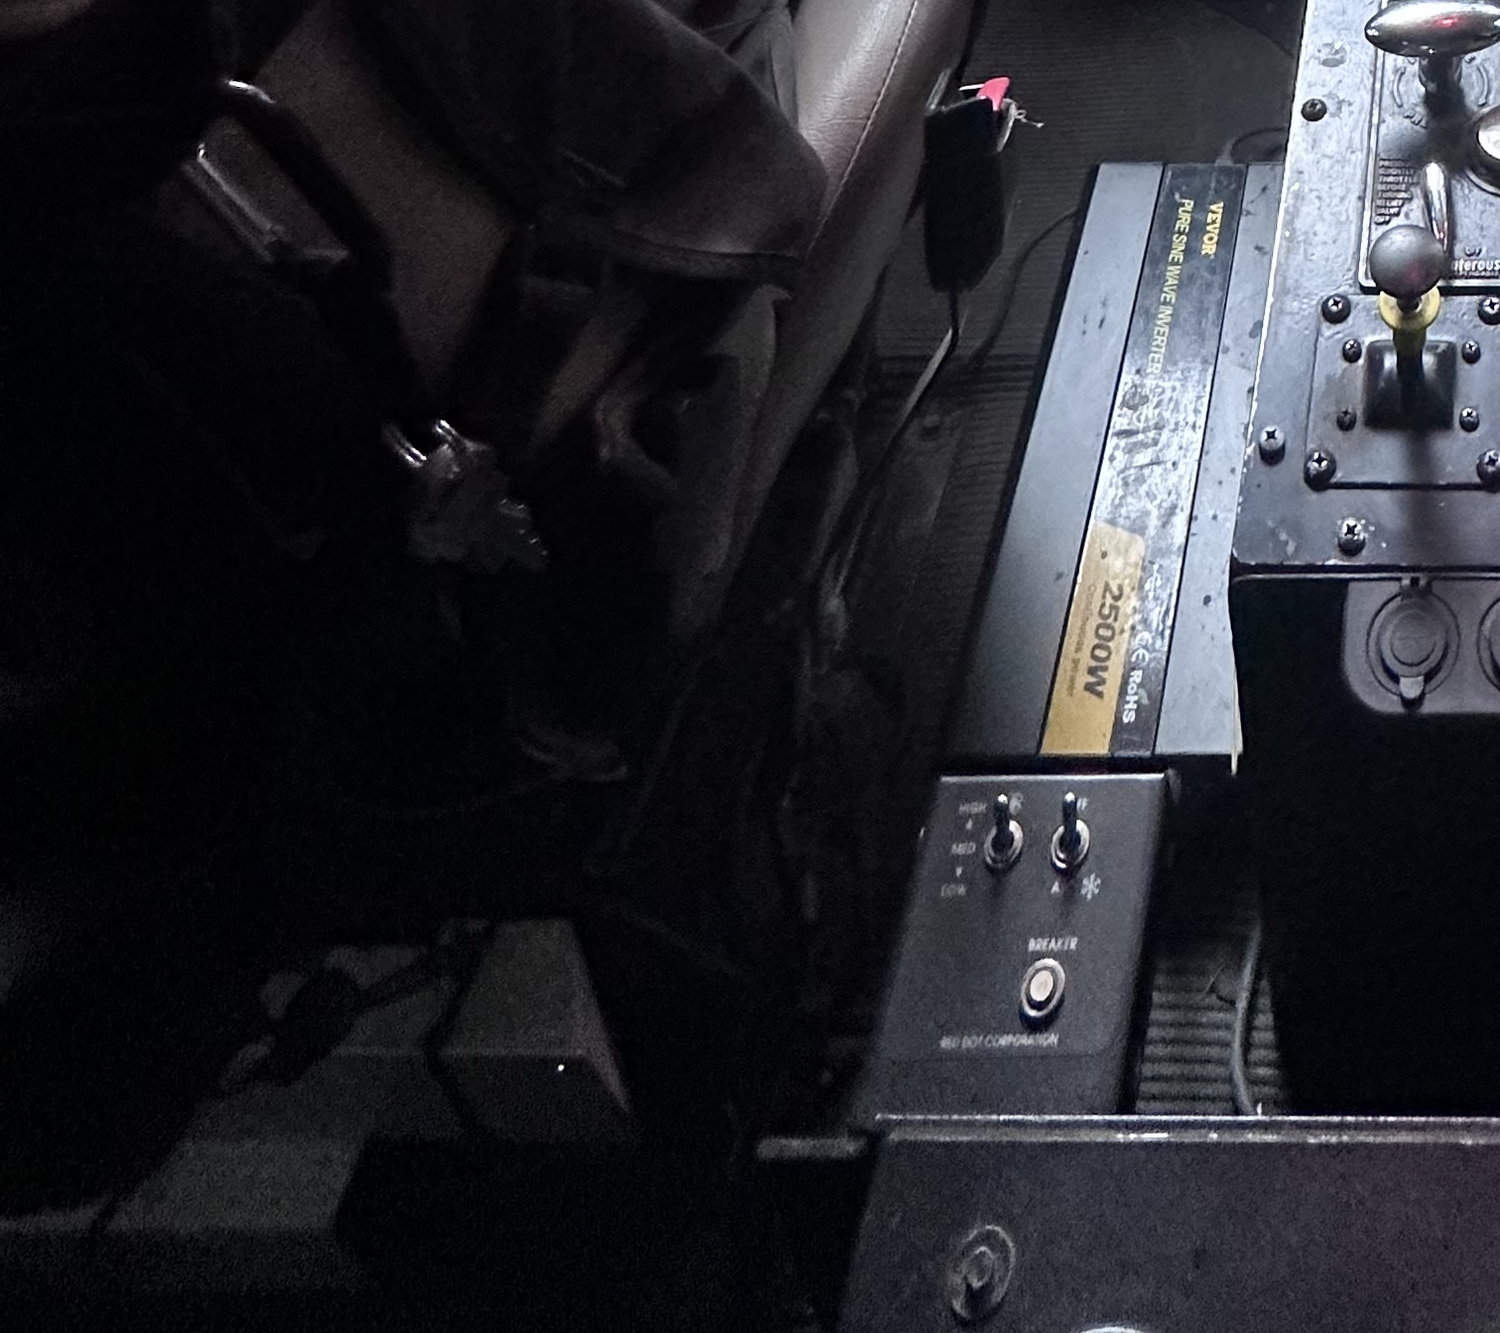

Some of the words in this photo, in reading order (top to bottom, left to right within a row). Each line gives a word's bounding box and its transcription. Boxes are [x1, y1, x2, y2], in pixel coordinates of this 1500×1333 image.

[1174, 198, 1195, 233] PURE
[1201, 201, 1224, 256] VEVOR
[1168, 234, 1188, 264] SINE
[1450, 258, 1500, 272] aterous
[1160, 265, 1182, 304] WAVE
[1146, 305, 1174, 374] INVERTER
[1083, 580, 1124, 700] 2500W
[1122, 668, 1144, 724] RoHS
[951, 842, 976, 855] MED
[1028, 936, 1079, 952] BREAKER
